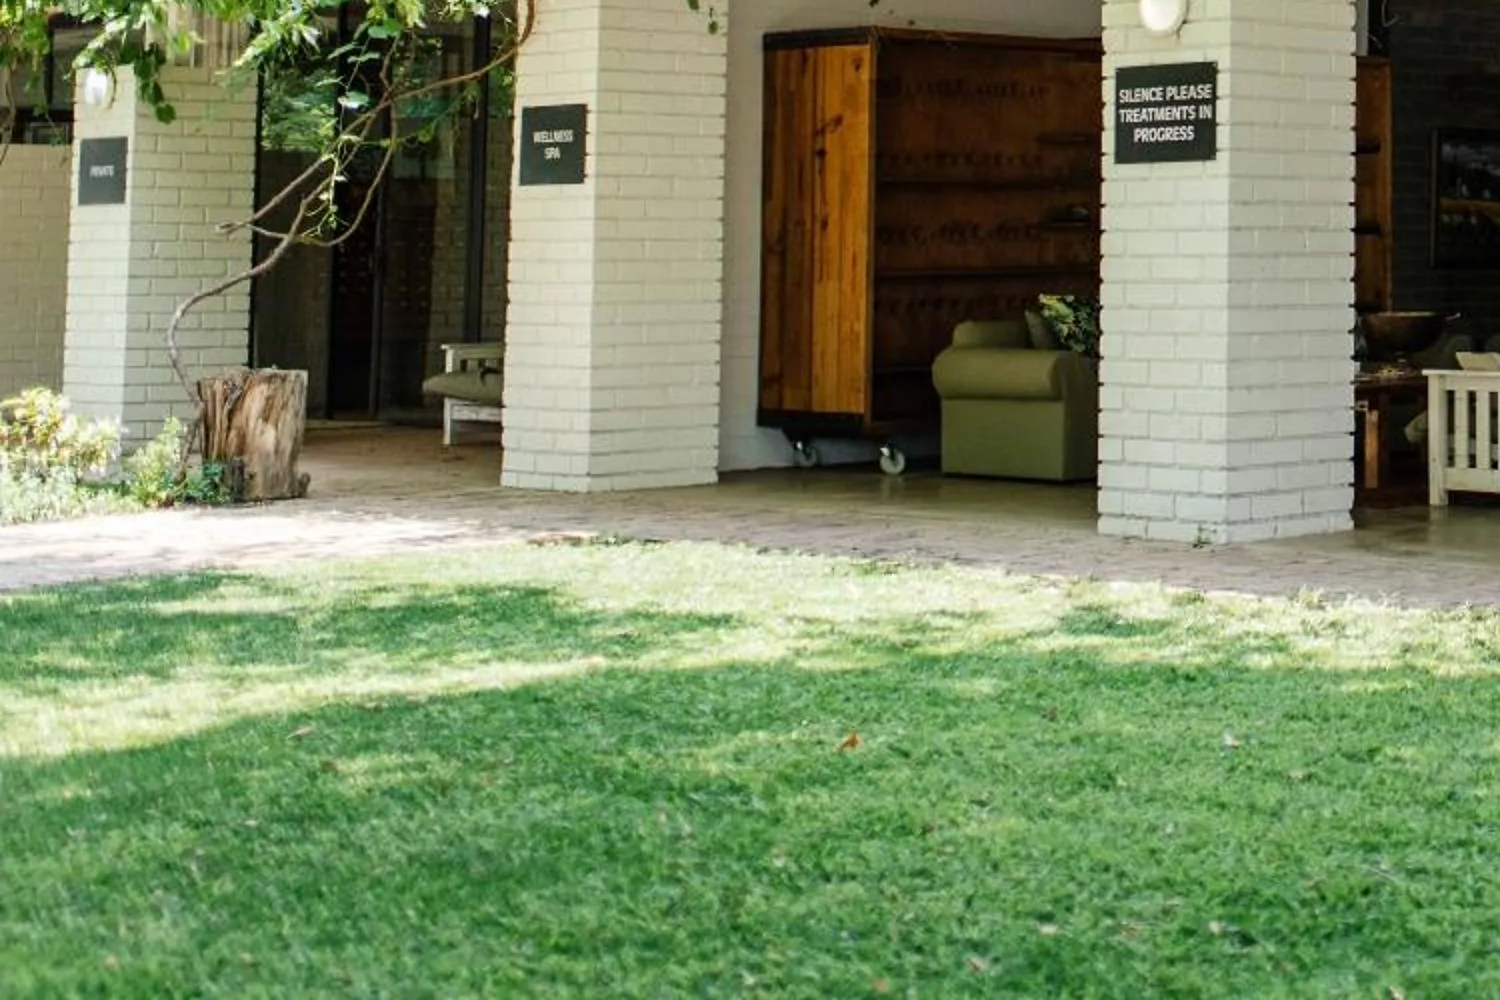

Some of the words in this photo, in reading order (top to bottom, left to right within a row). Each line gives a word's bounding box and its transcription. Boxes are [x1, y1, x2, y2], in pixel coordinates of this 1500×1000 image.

[1119, 87, 1164, 103] SILENCE
[1166, 83, 1213, 101] PLEASE
[1119, 105, 1196, 123] TREATMENTS
[1199, 103, 1213, 119] IN
[1133, 125, 1195, 143] PROGRESS
